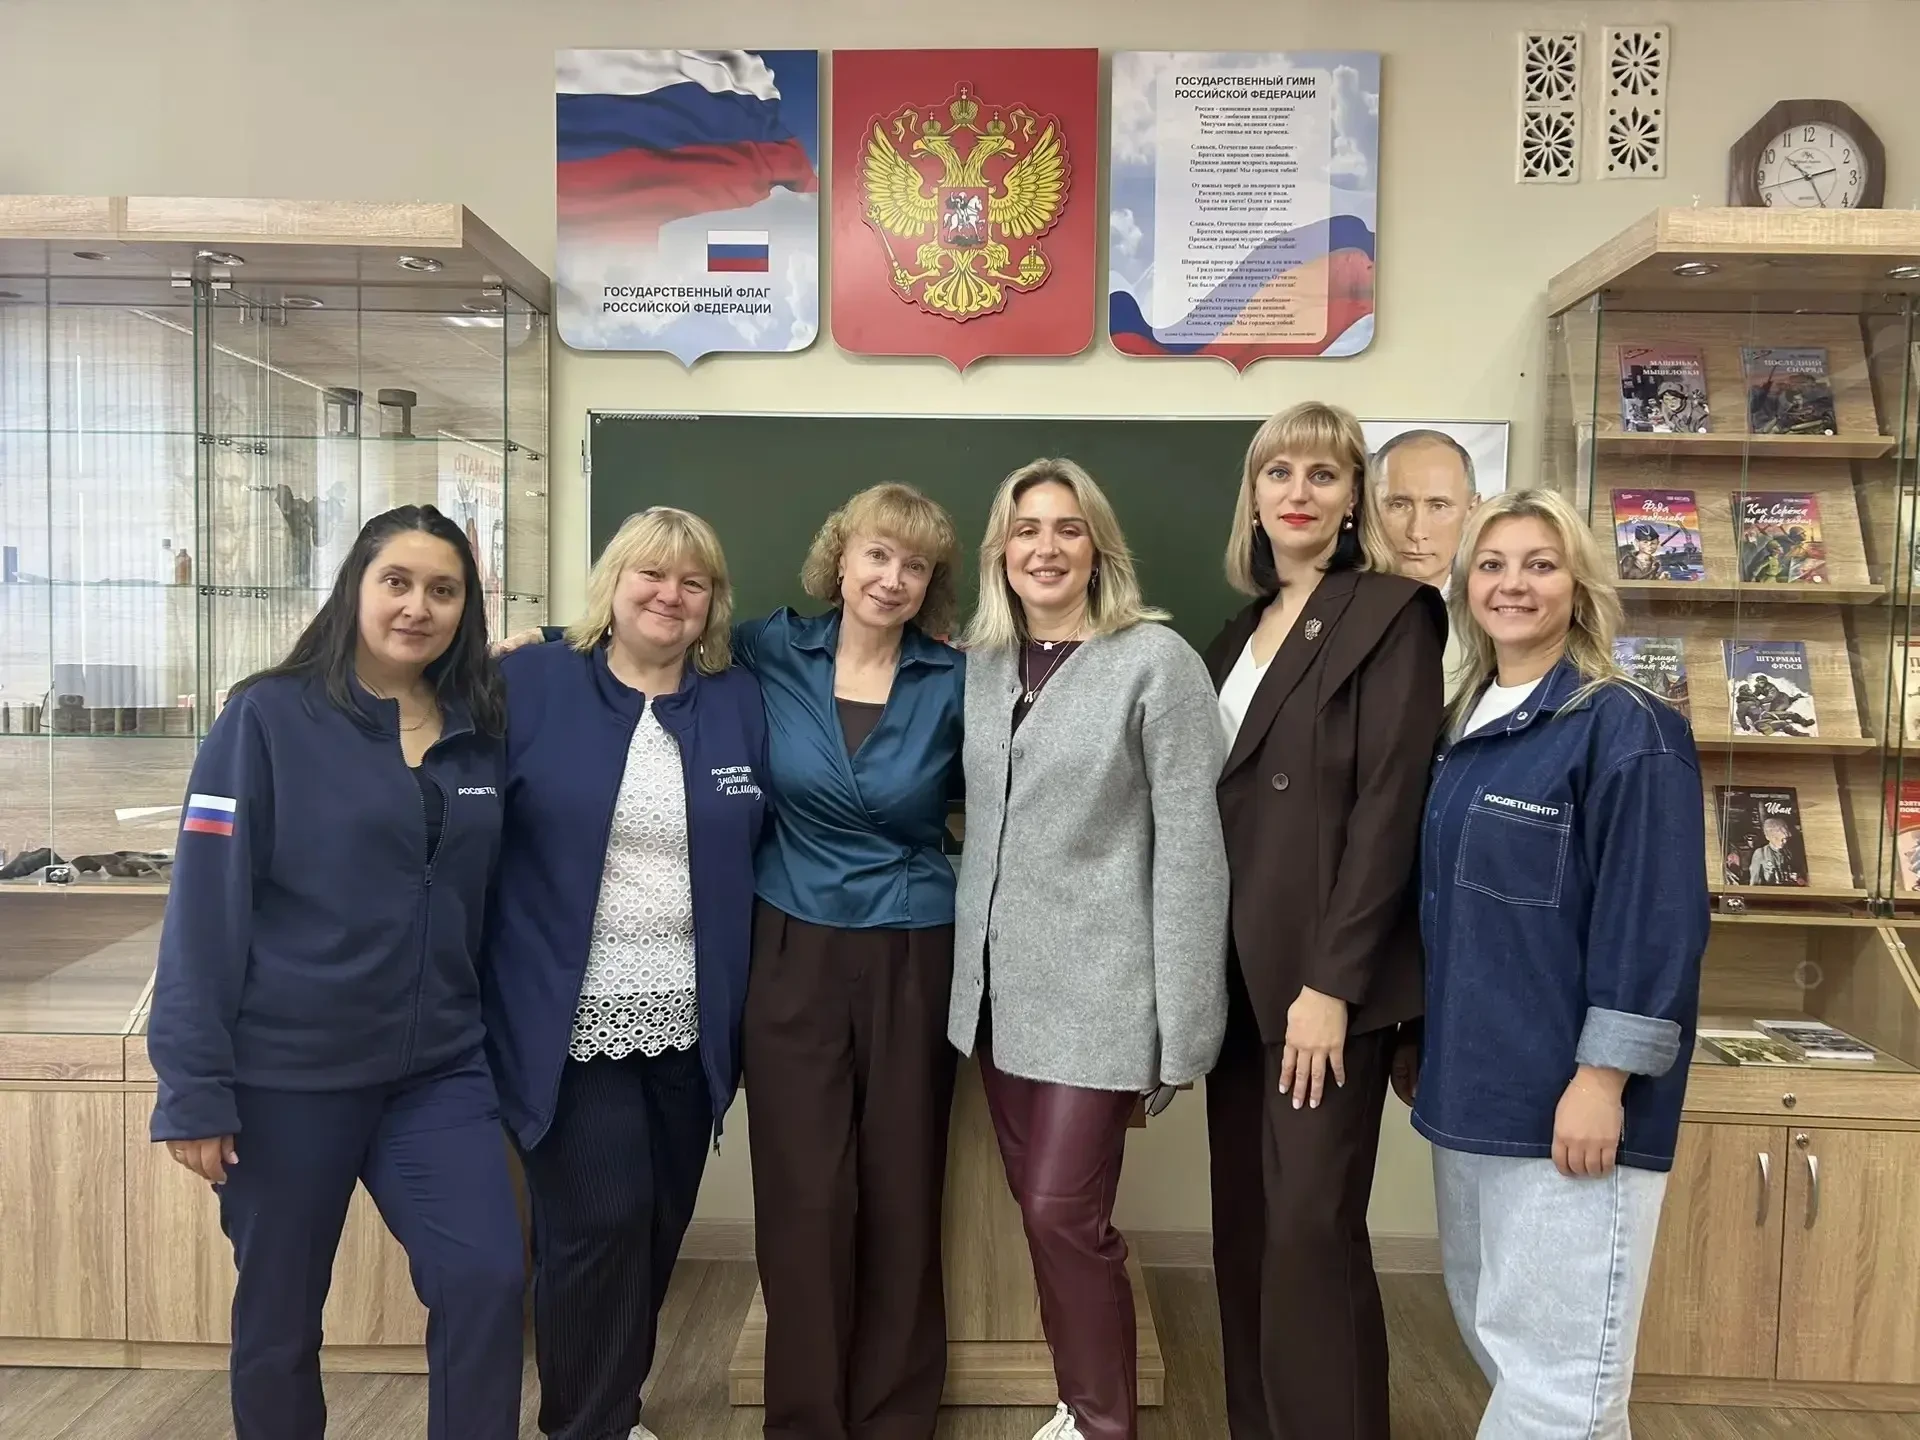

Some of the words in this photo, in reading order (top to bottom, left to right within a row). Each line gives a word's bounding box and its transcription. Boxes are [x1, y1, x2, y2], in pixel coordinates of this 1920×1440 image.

[1175, 75, 1284, 87] ГОСУДАРСТВЕННЫЙ
[1286, 76, 1316, 86] ГИМН
[1174, 88, 1248, 99] РОССИЙСКОЙ
[1250, 89, 1316, 100] ФЕДЕРАЦИИ
[1782, 132, 1791, 148] 11
[1803, 126, 1816, 142] 12
[1829, 132, 1834, 148] 1
[1764, 149, 1776, 165] 10
[1842, 148, 1850, 164] 2
[1757, 170, 1766, 185] 9
[1849, 169, 1858, 186] 3
[1764, 192, 1773, 207] 8
[1841, 192, 1849, 207] 4
[603, 285, 733, 299] ГОСУДАРСТВЕННЫЙ
[736, 287, 771, 299] ФЛАГ
[602, 300, 690, 313] РОССИЙСКОЙ
[693, 302, 772, 315] ФЕДЕРАЦИИ
[1649, 359, 1699, 367] МАШЕНЬКА
[1763, 359, 1822, 367] ПОСЛЕДНИЙ
[1786, 366, 1824, 374] СНАРЯД
[1642, 499, 1670, 513] Федя
[1746, 503, 1768, 515] Как
[1755, 655, 1802, 663] ШТУРМАН
[1771, 662, 1803, 670] ФРОСЯ
[1483, 793, 1560, 816] РОСДЕТЦЕНТР
[1764, 801, 1792, 815] Иван
